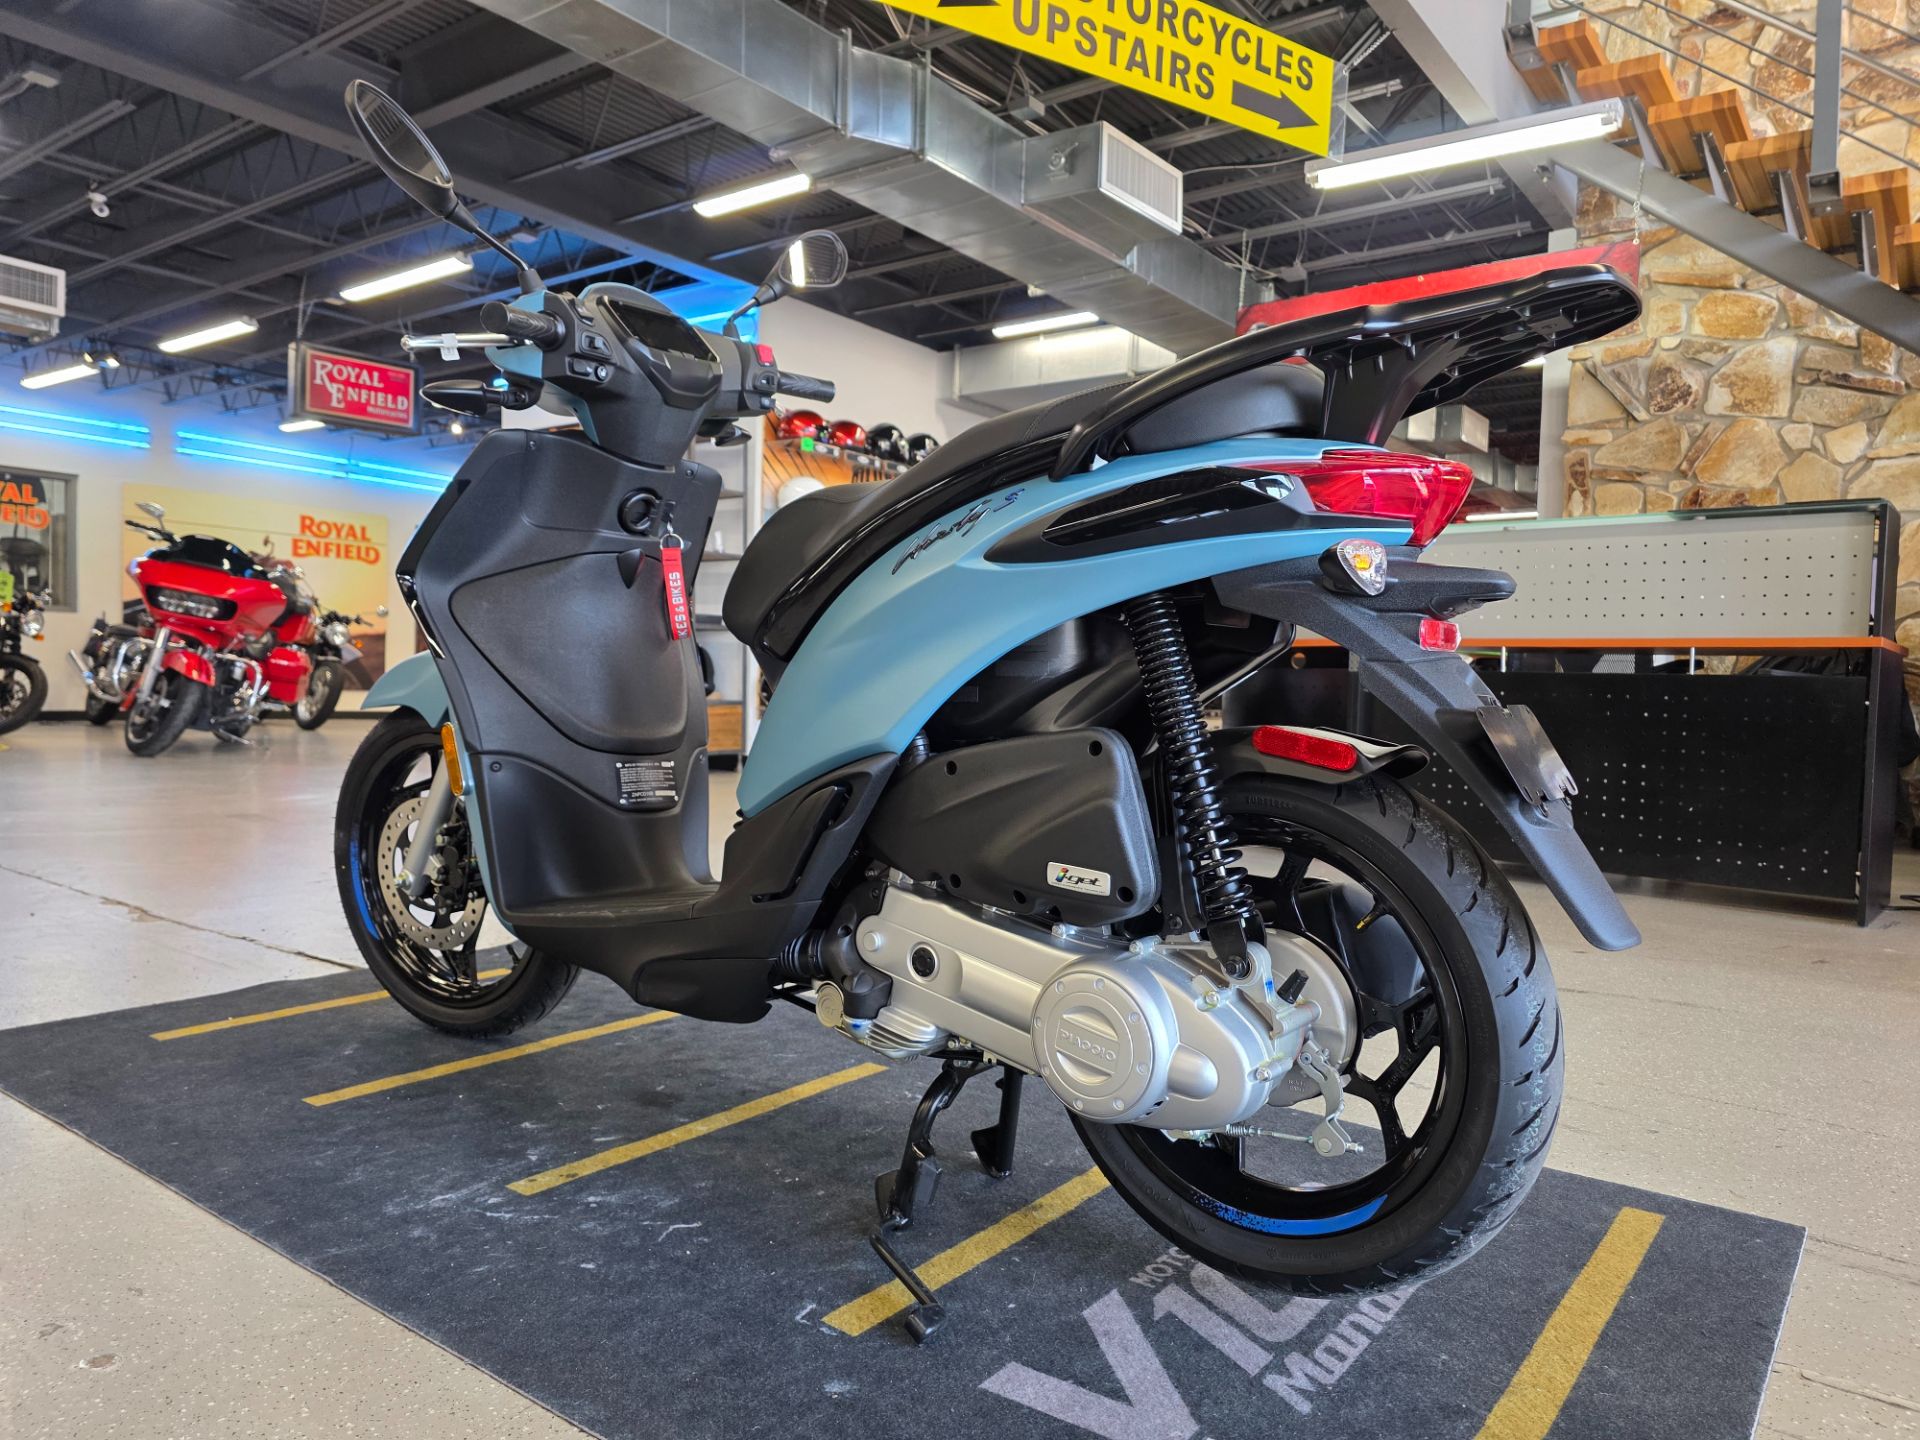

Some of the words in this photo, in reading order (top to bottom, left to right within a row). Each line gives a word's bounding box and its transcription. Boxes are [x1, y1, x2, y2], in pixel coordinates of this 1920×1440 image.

[1012, 0, 1215, 101] UPSTAIRS
[313, 359, 384, 391] ROYAL
[330, 383, 409, 410] ENFIELD
[299, 514, 371, 543] ROYAL
[291, 537, 380, 565] ENFIELD
[668, 571, 684, 605] BIKES
